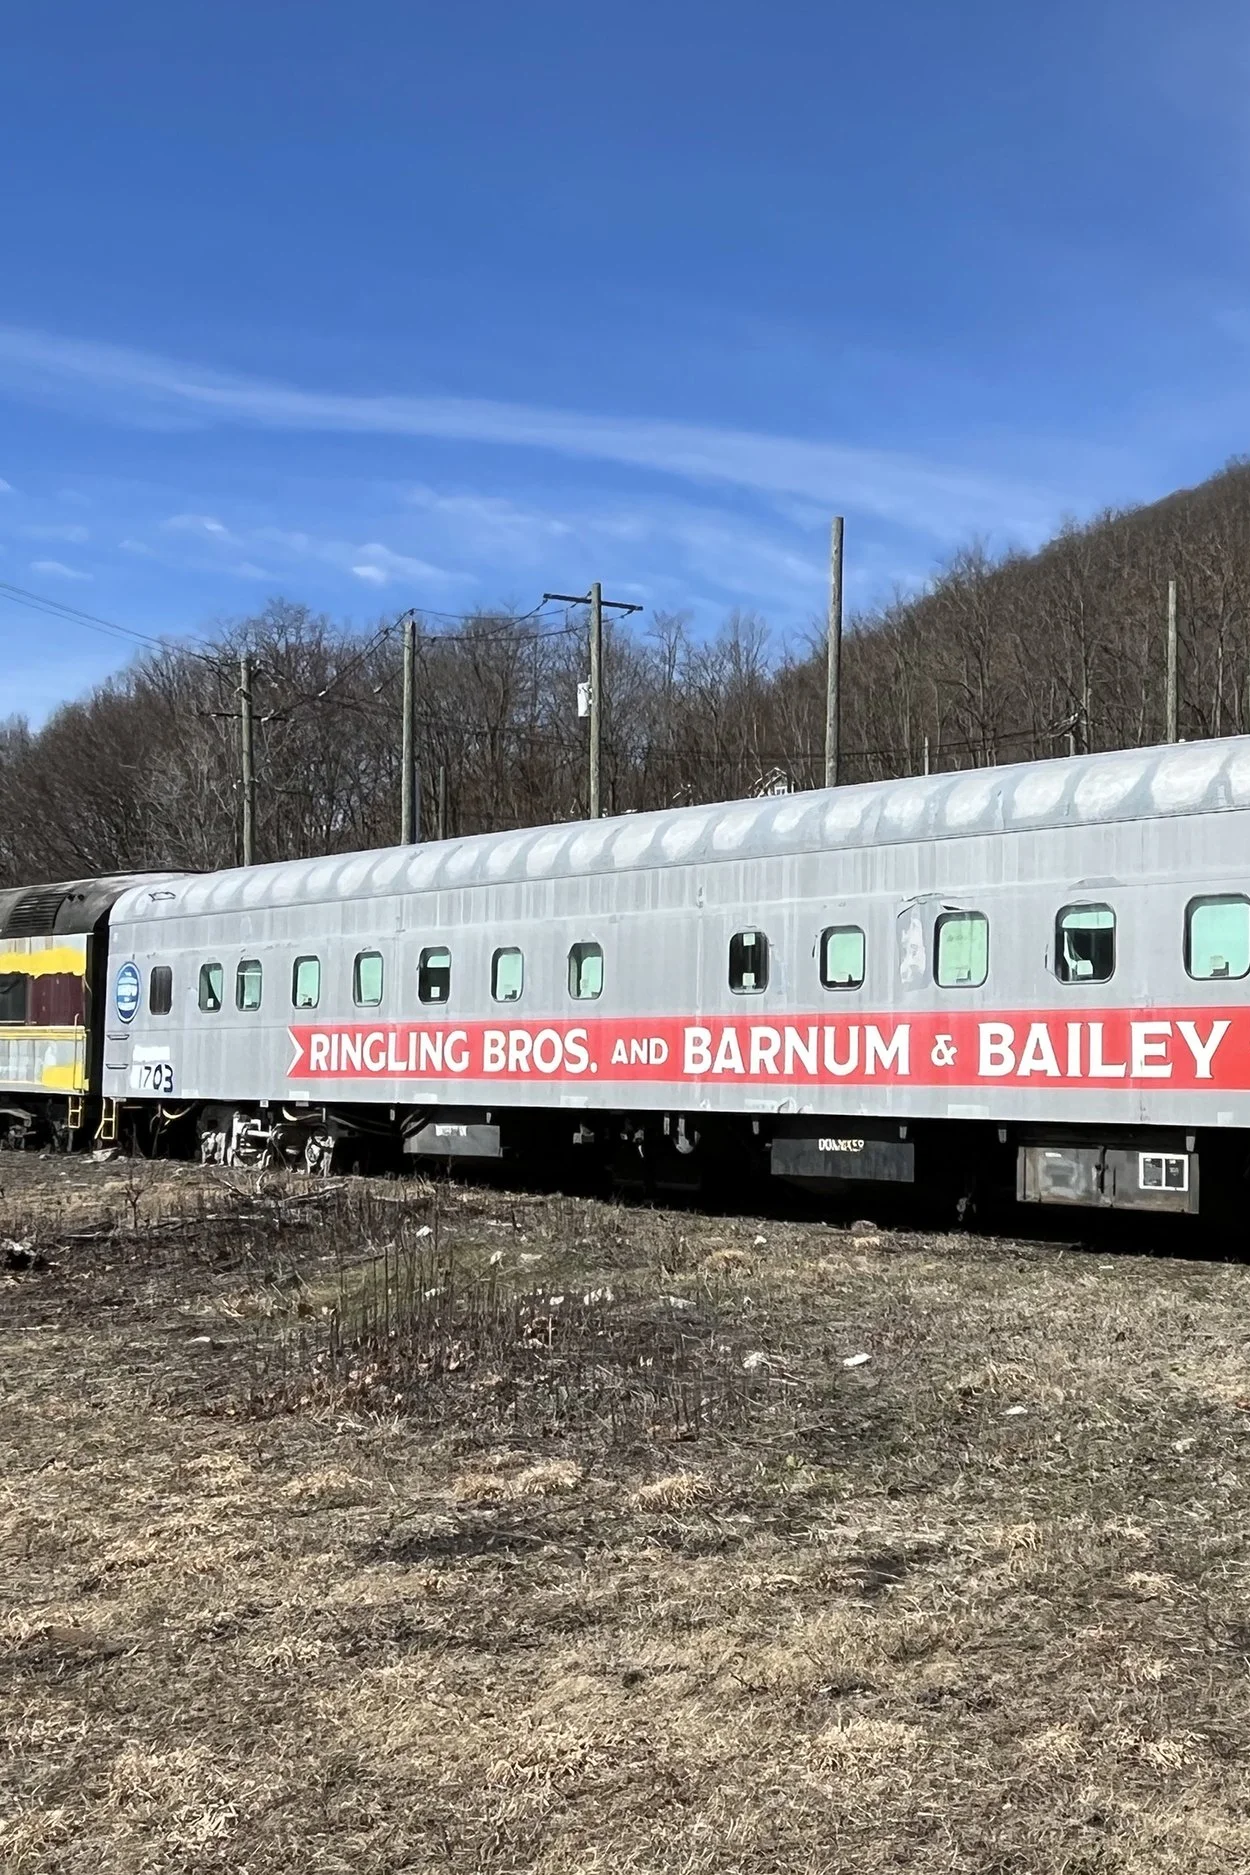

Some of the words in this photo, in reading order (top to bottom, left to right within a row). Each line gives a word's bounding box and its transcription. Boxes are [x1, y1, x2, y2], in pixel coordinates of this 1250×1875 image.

[309, 1030, 470, 1073] RINGLING
[482, 1027, 598, 1074] BROS.
[610, 1037, 669, 1066] AND
[682, 1023, 912, 1076] BARNUM
[930, 1034, 958, 1067] &
[977, 1020, 1232, 1080] BAILEY
[138, 1063, 174, 1093] 1703
